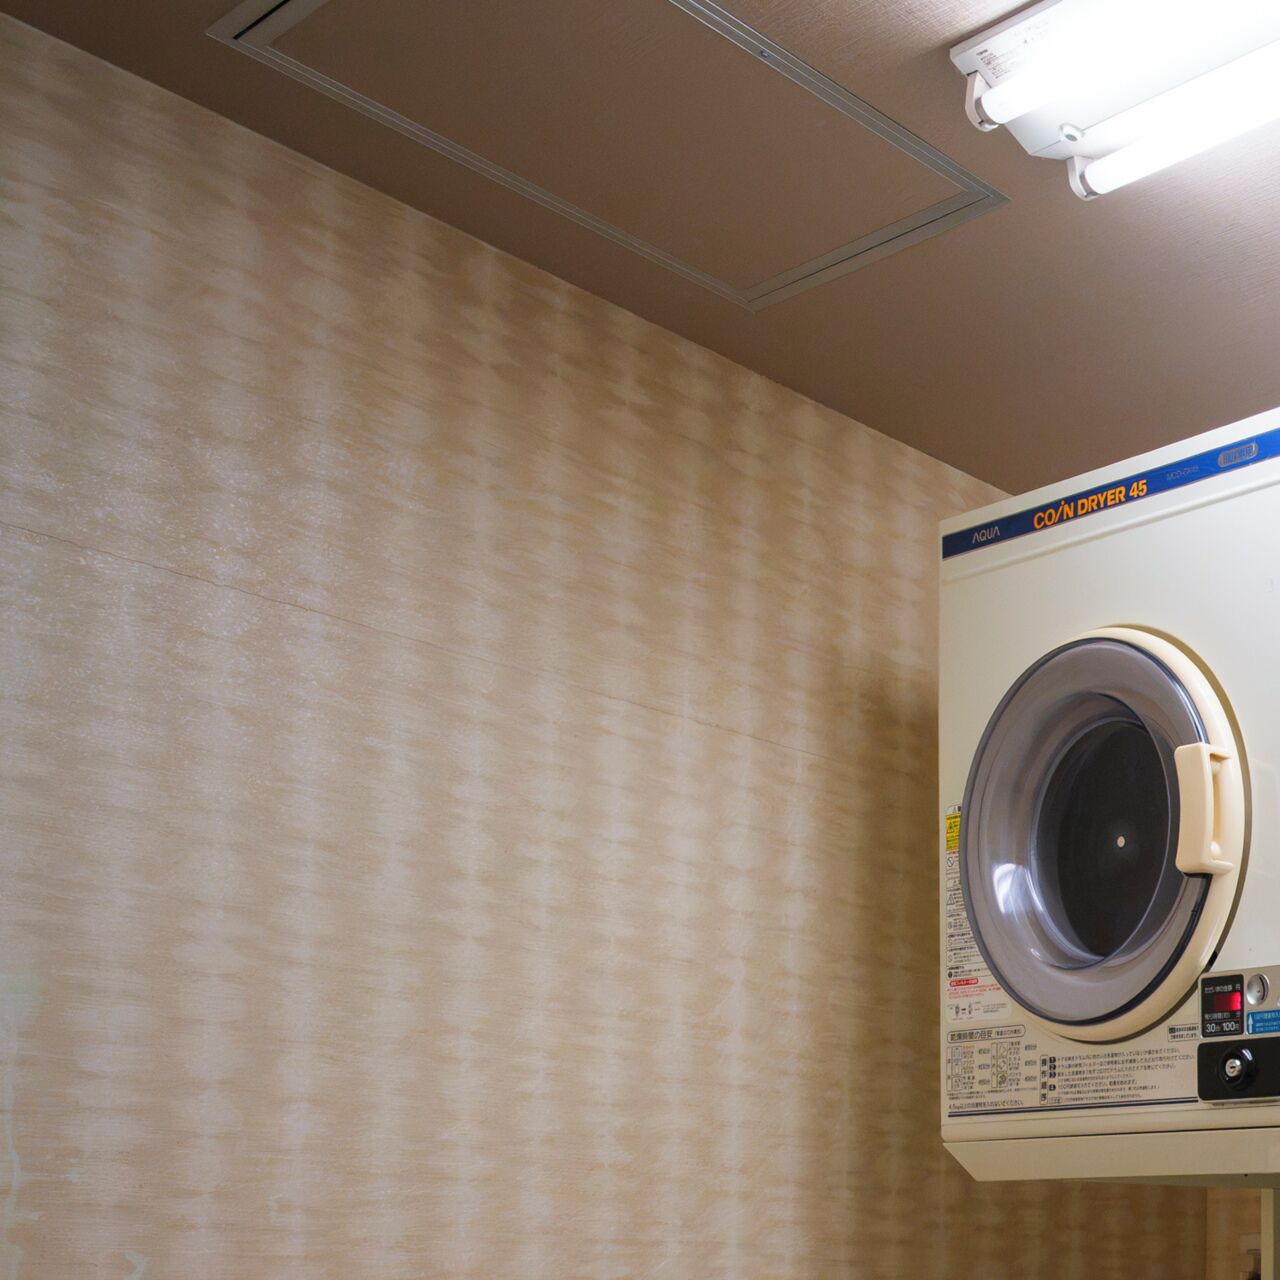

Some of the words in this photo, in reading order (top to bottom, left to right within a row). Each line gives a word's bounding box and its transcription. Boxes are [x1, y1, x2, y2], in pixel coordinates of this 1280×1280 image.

[972, 526, 1000, 544] AQUA
[1077, 486, 1126, 515] DRYER
[1129, 479, 1147, 498] 45
